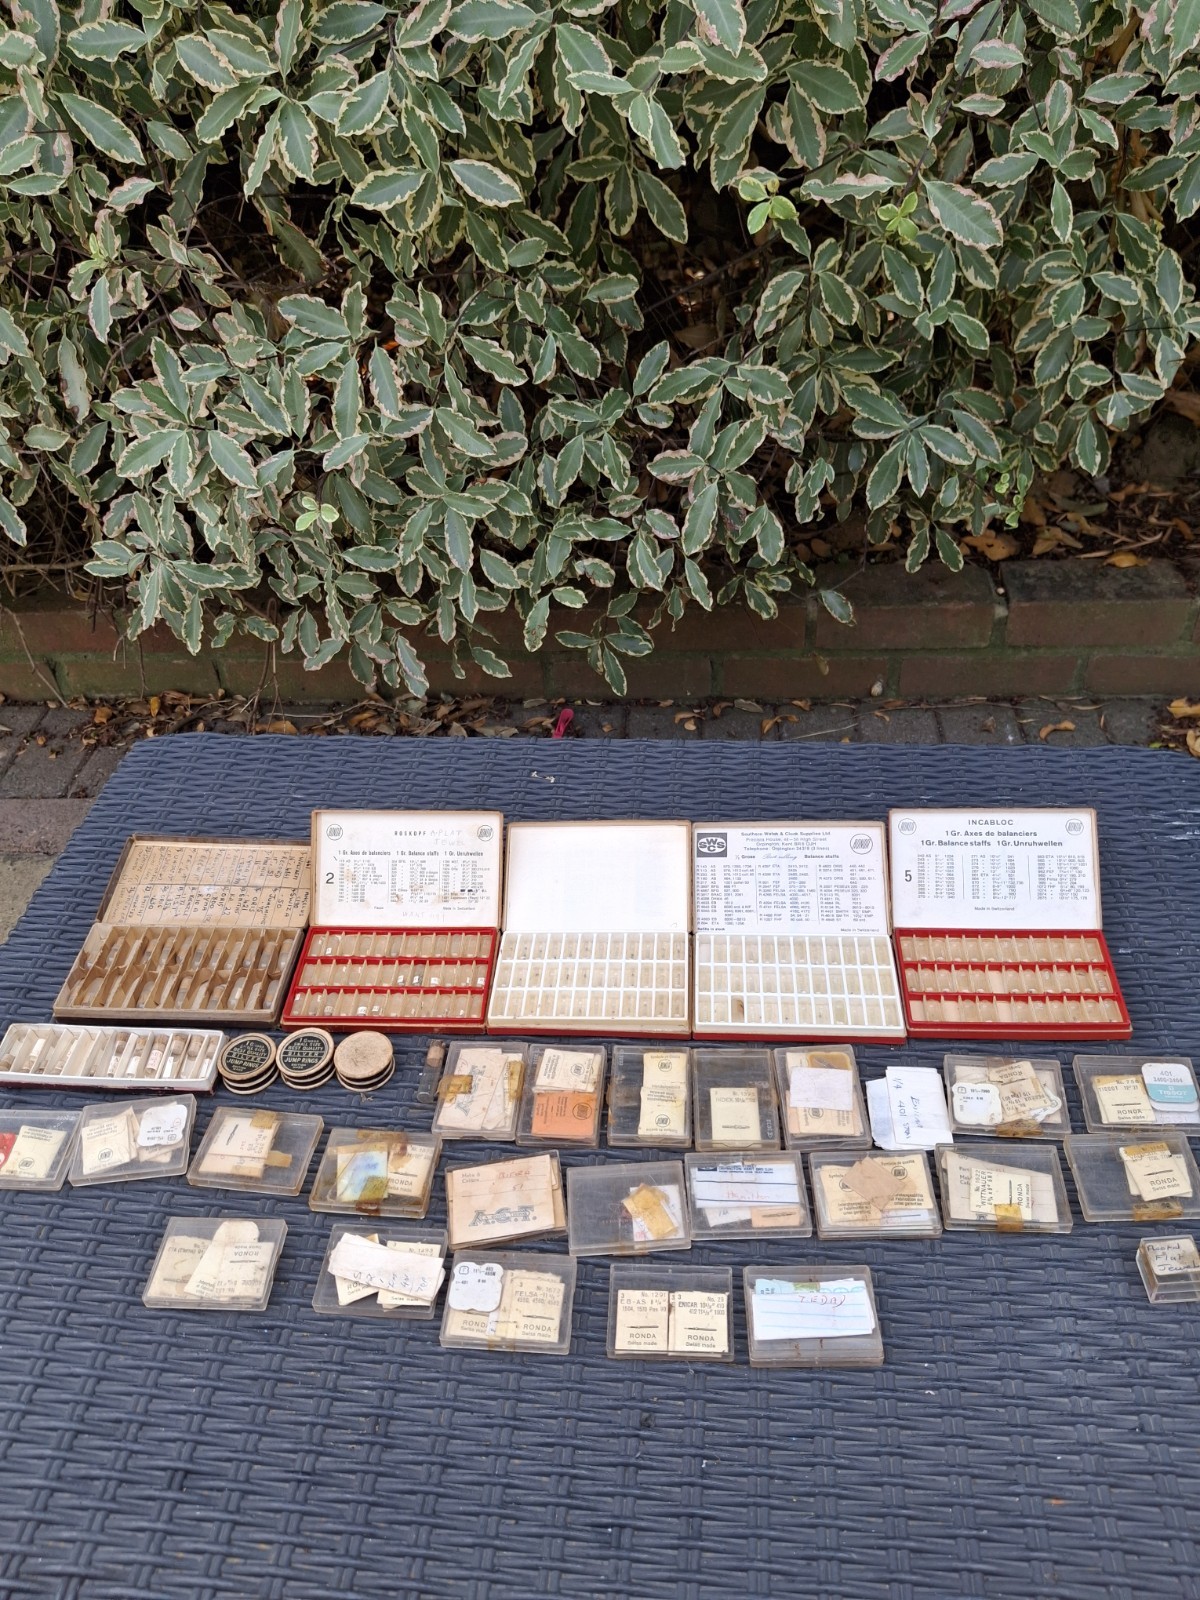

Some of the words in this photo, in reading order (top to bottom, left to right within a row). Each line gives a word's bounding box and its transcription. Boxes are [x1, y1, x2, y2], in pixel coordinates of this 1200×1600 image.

[326, 872, 334, 884] 2
[904, 870, 912, 882] 5
[1150, 1177, 1177, 1186] RONDA
